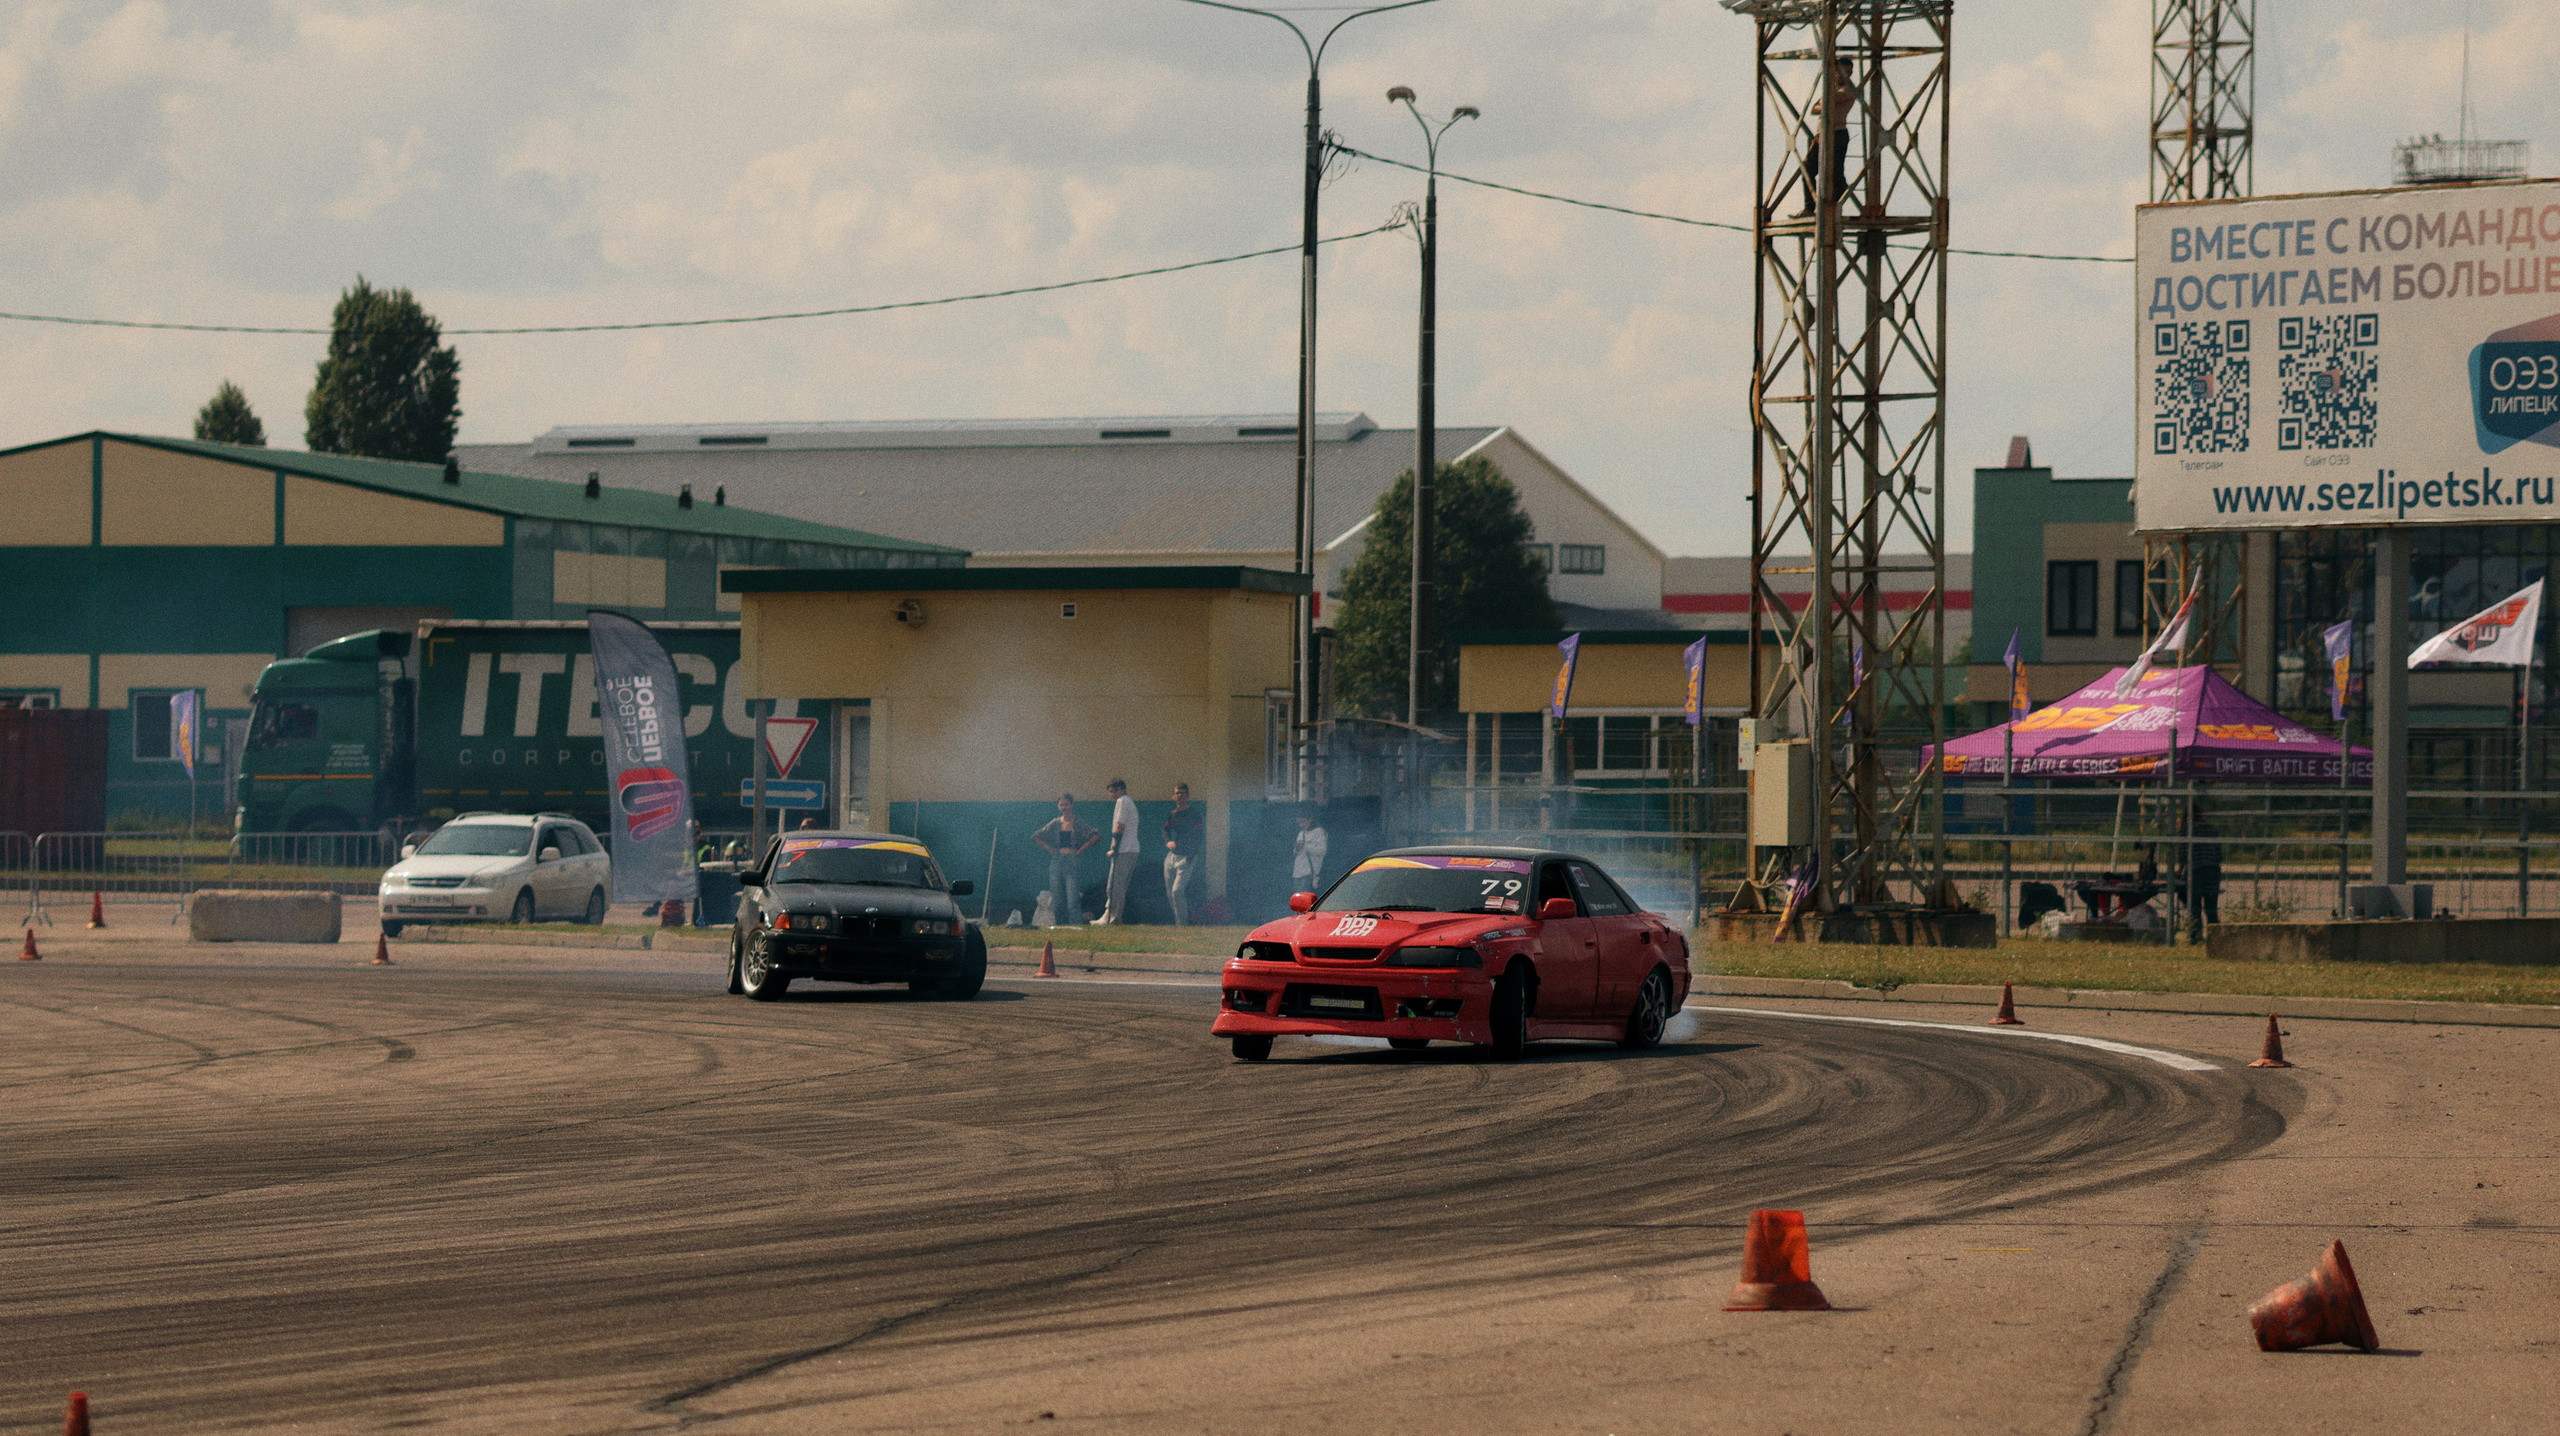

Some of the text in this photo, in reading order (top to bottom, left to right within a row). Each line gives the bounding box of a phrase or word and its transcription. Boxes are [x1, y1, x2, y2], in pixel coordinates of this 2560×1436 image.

[2171, 220, 2316, 263] ВМЕСТЕ
[2325, 217, 2348, 255] С
[2148, 265, 2381, 320] ДОСТИГАЕМ
[2489, 355, 2559, 391] ОЭЗ
[2488, 395, 2559, 415] ЛИПЕЦК
[2212, 467, 2554, 519] www.sezlipetsk.ru
[2020, 757, 2067, 773] BATTLE
[2072, 758, 2119, 774] SERIES
[2215, 758, 2374, 778] DRIFT BATTLE SEIES
[1481, 879, 1523, 896] 79
